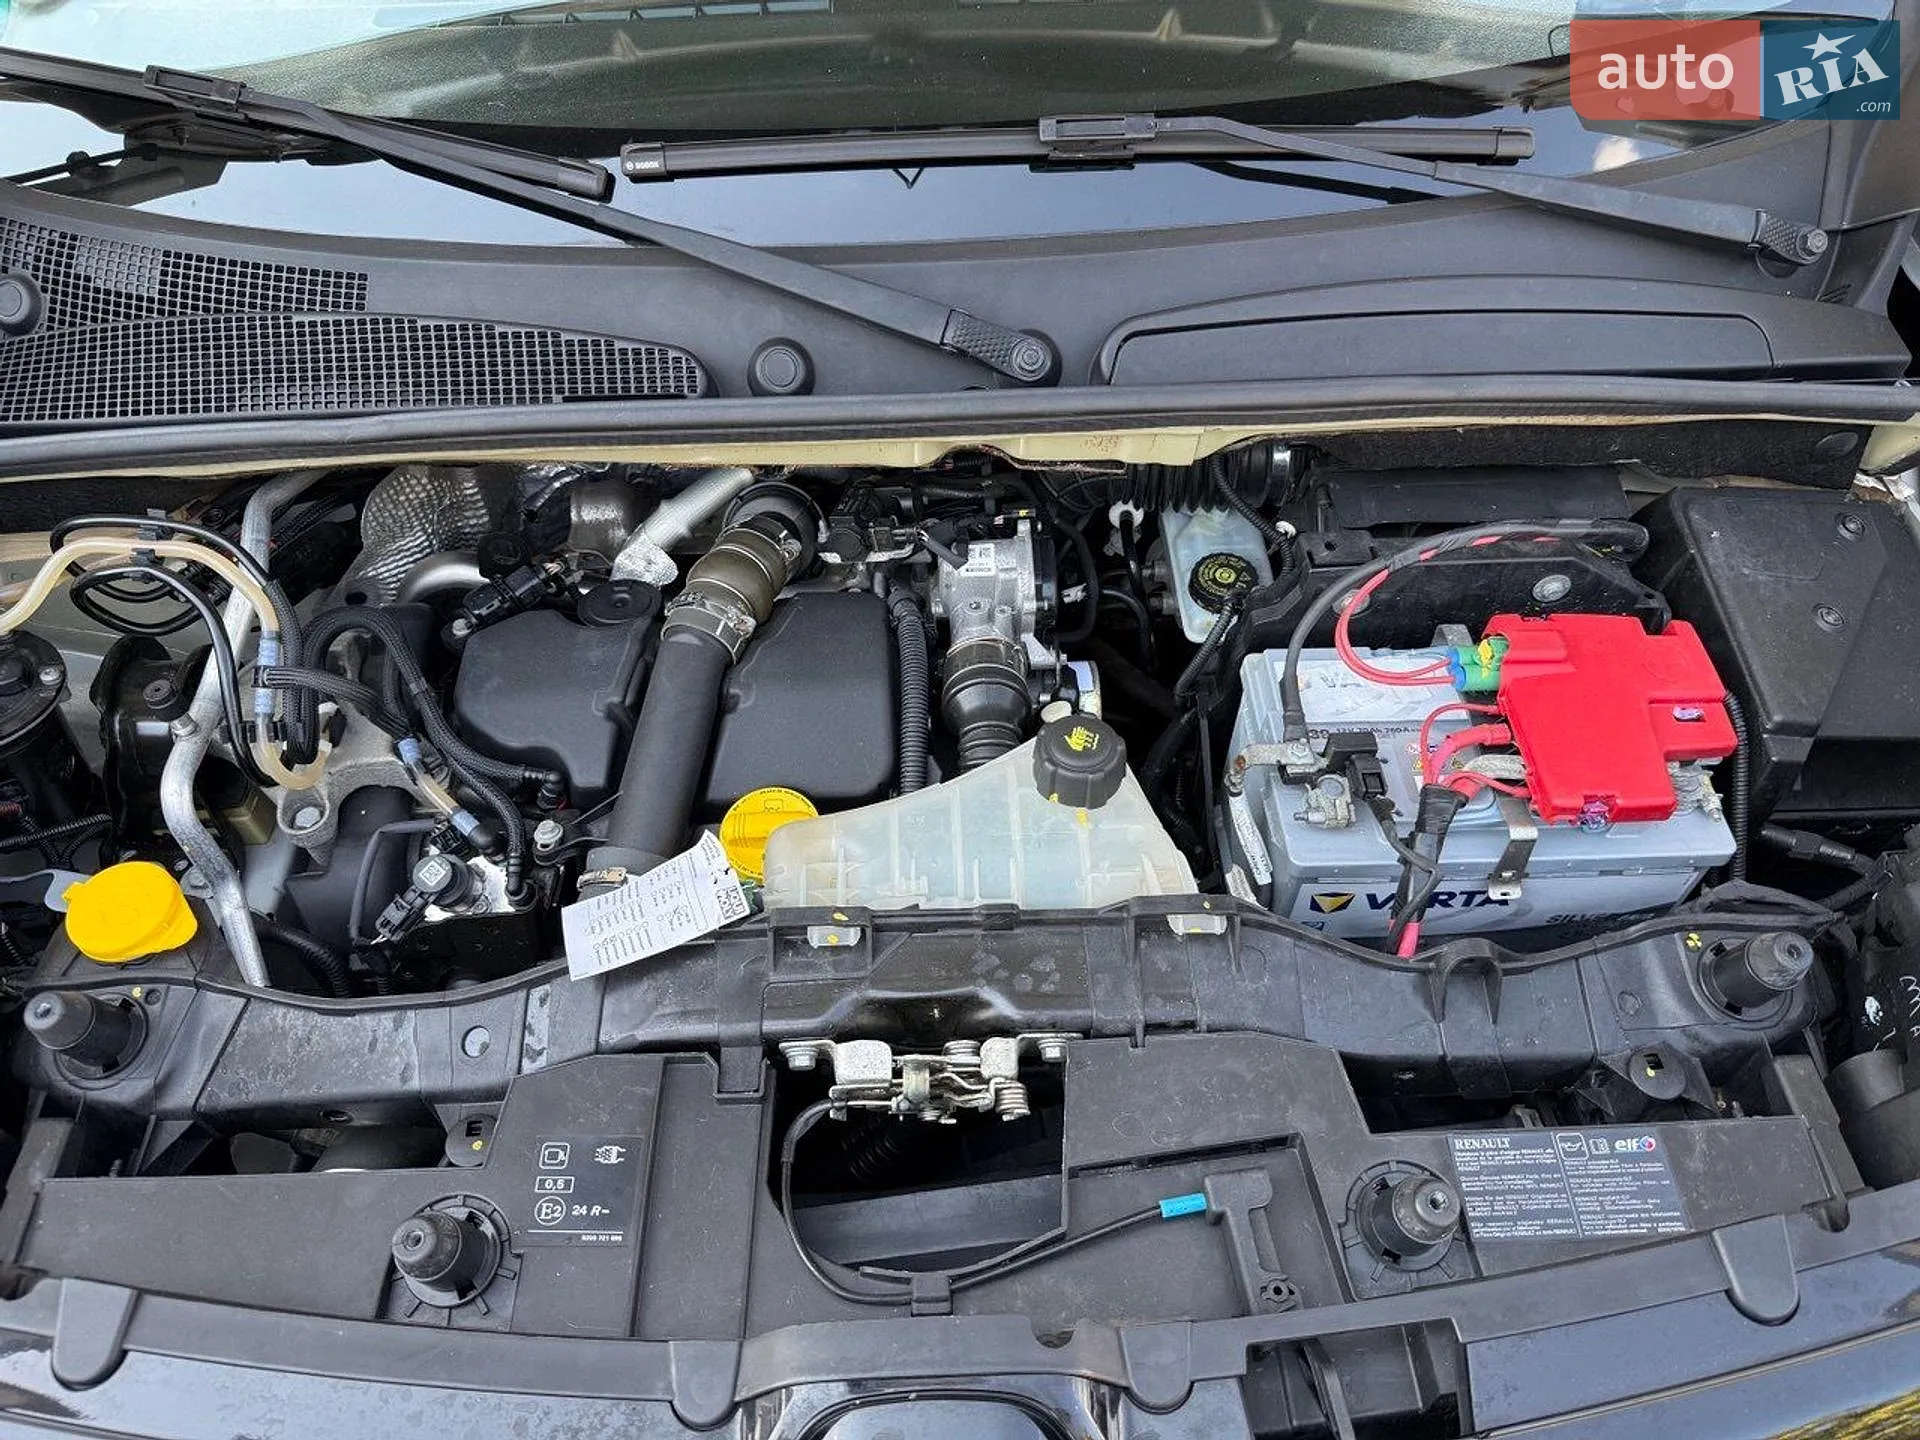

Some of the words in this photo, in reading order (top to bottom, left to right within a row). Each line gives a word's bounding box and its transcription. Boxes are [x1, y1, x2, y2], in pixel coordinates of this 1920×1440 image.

[1366, 890, 1509, 909] VRTA
[1454, 1137, 1510, 1150] RENAULT
[571, 1205, 588, 1216] 24
